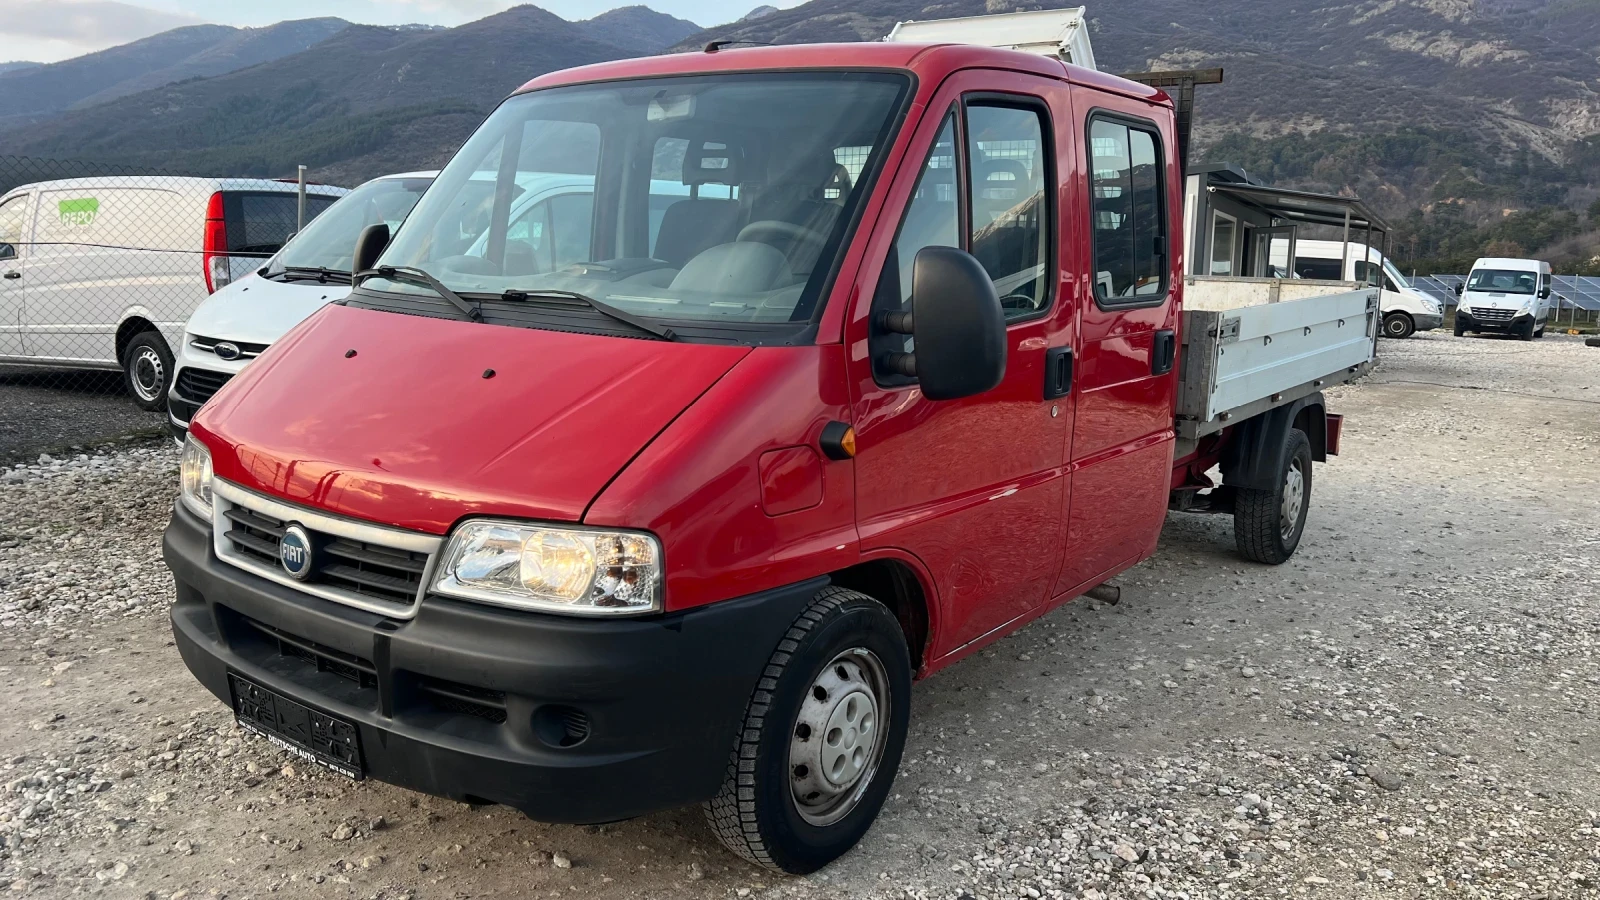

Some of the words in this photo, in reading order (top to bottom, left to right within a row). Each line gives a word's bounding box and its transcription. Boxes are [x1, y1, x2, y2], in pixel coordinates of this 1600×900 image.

[282, 542, 303, 564] FIAT
[267, 733, 299, 755] DEUTSCHE
[298, 749, 317, 763] AUTO
